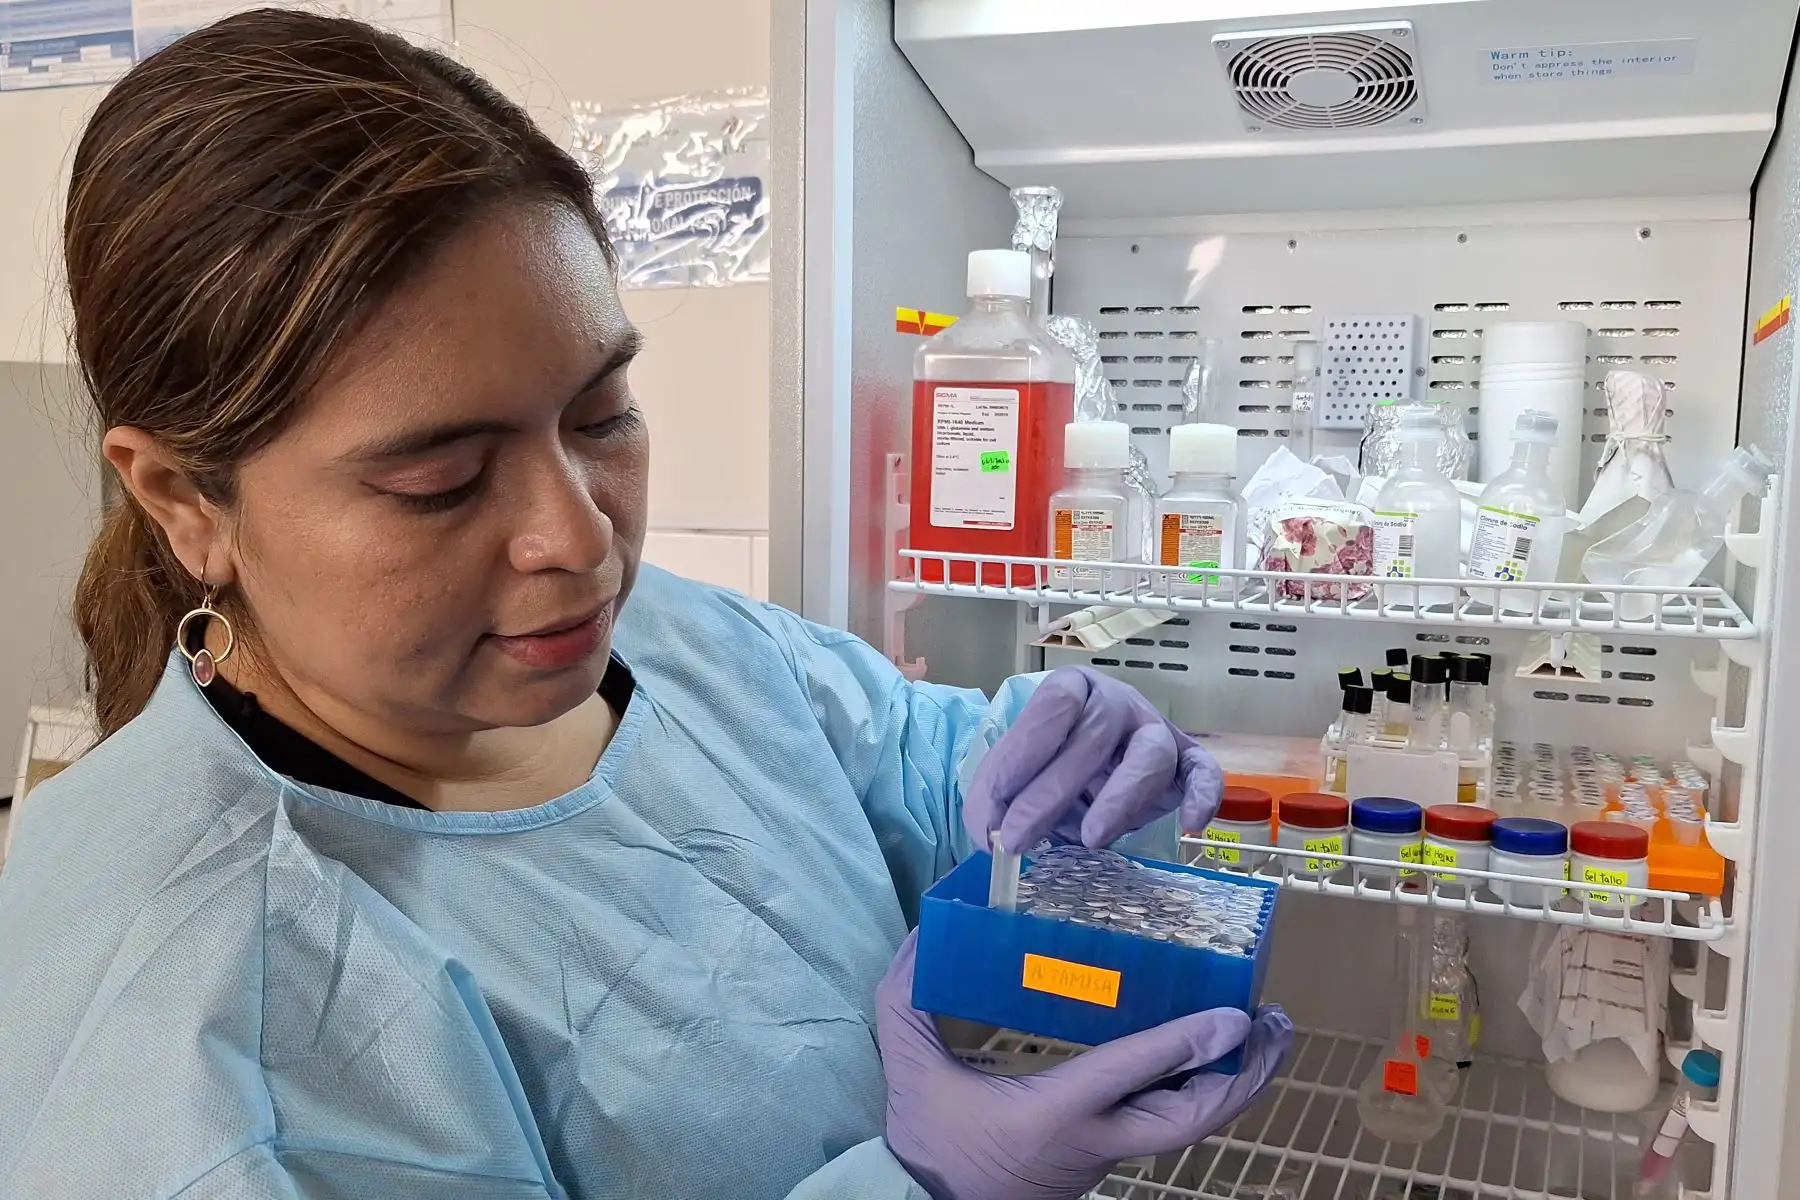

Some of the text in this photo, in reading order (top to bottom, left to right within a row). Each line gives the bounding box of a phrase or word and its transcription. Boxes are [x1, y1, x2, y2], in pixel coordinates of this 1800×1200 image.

[1490, 49, 1573, 60] Warm tip:
[1492, 62, 1526, 71] Don't
[1621, 55, 1677, 64] interior
[1528, 70, 1563, 78] store
[1571, 67, 1612, 76] things
[1585, 869, 1597, 881] Gel
